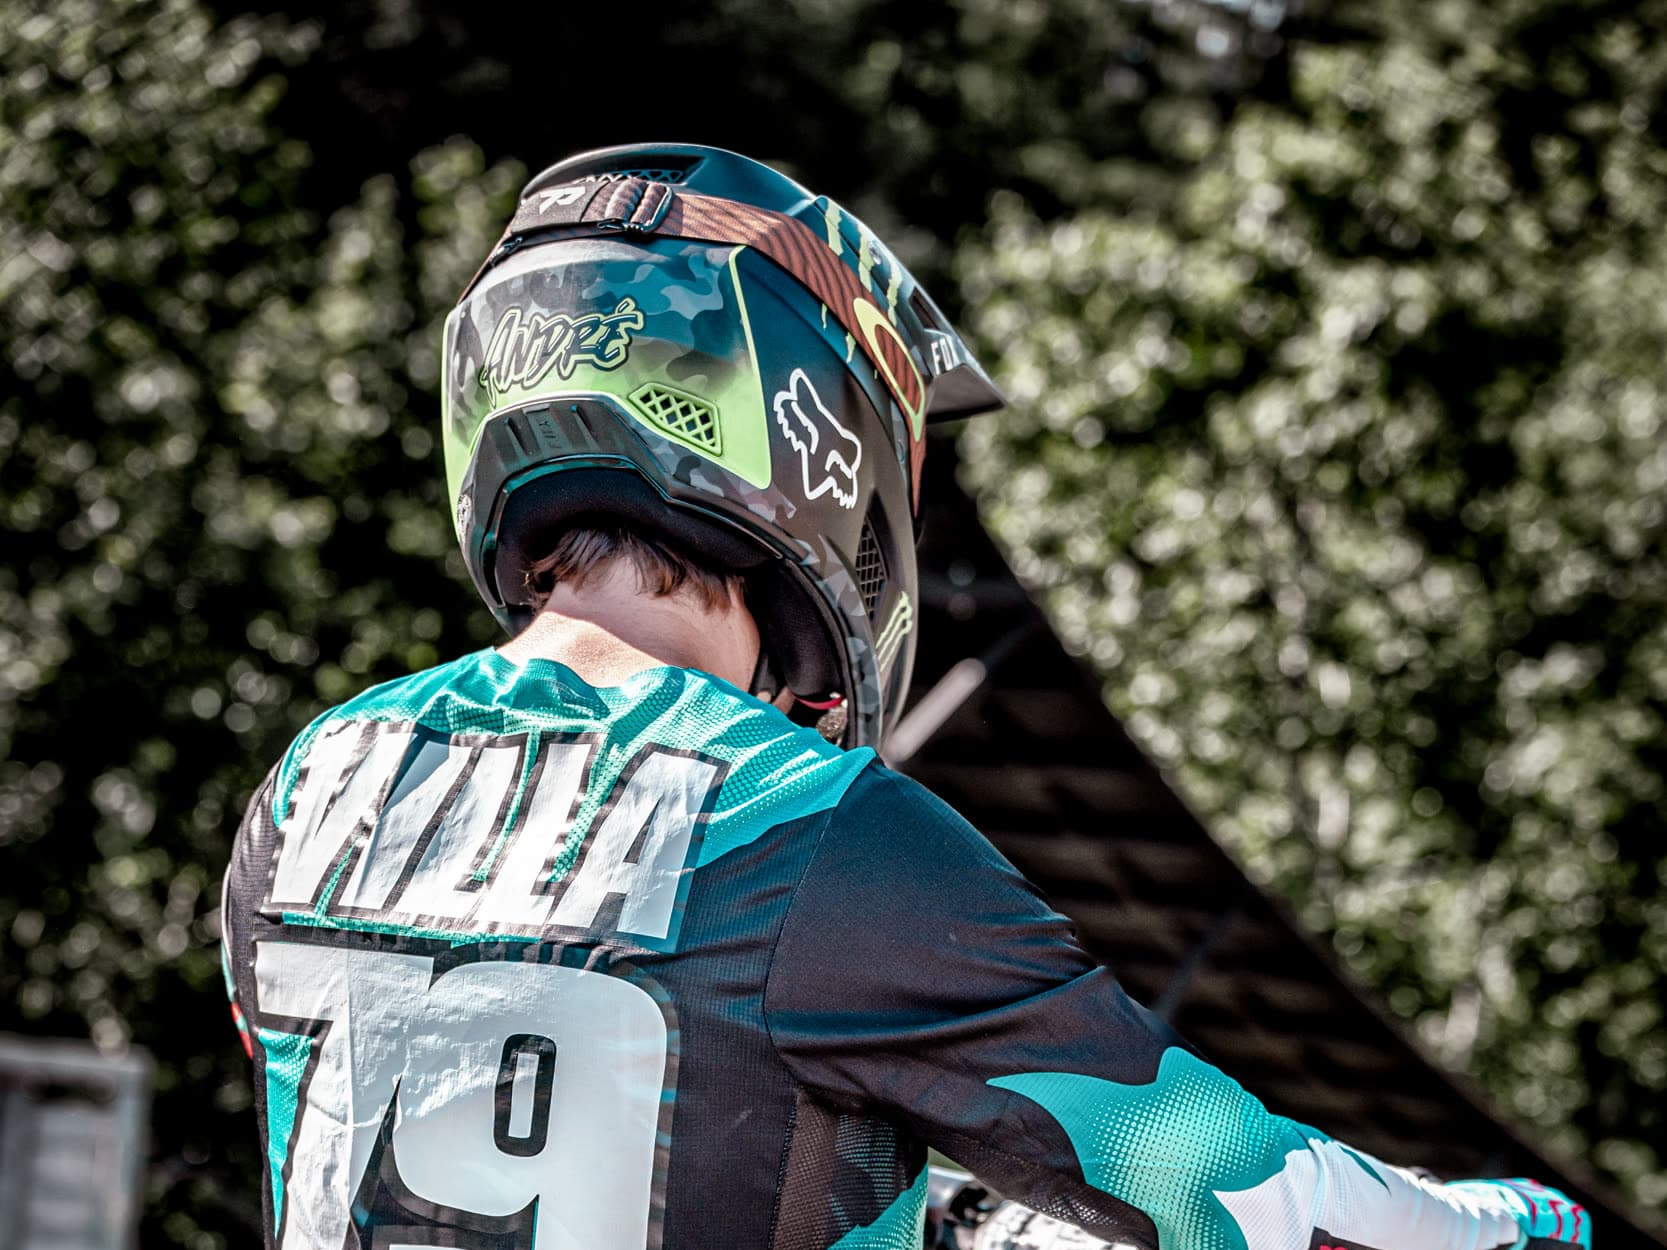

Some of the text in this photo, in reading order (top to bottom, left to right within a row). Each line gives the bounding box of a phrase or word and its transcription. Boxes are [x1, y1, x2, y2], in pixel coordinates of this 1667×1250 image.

[480, 298, 644, 407] ANDRÉ
[931, 338, 954, 376] FO
[268, 721, 722, 942] VILLA
